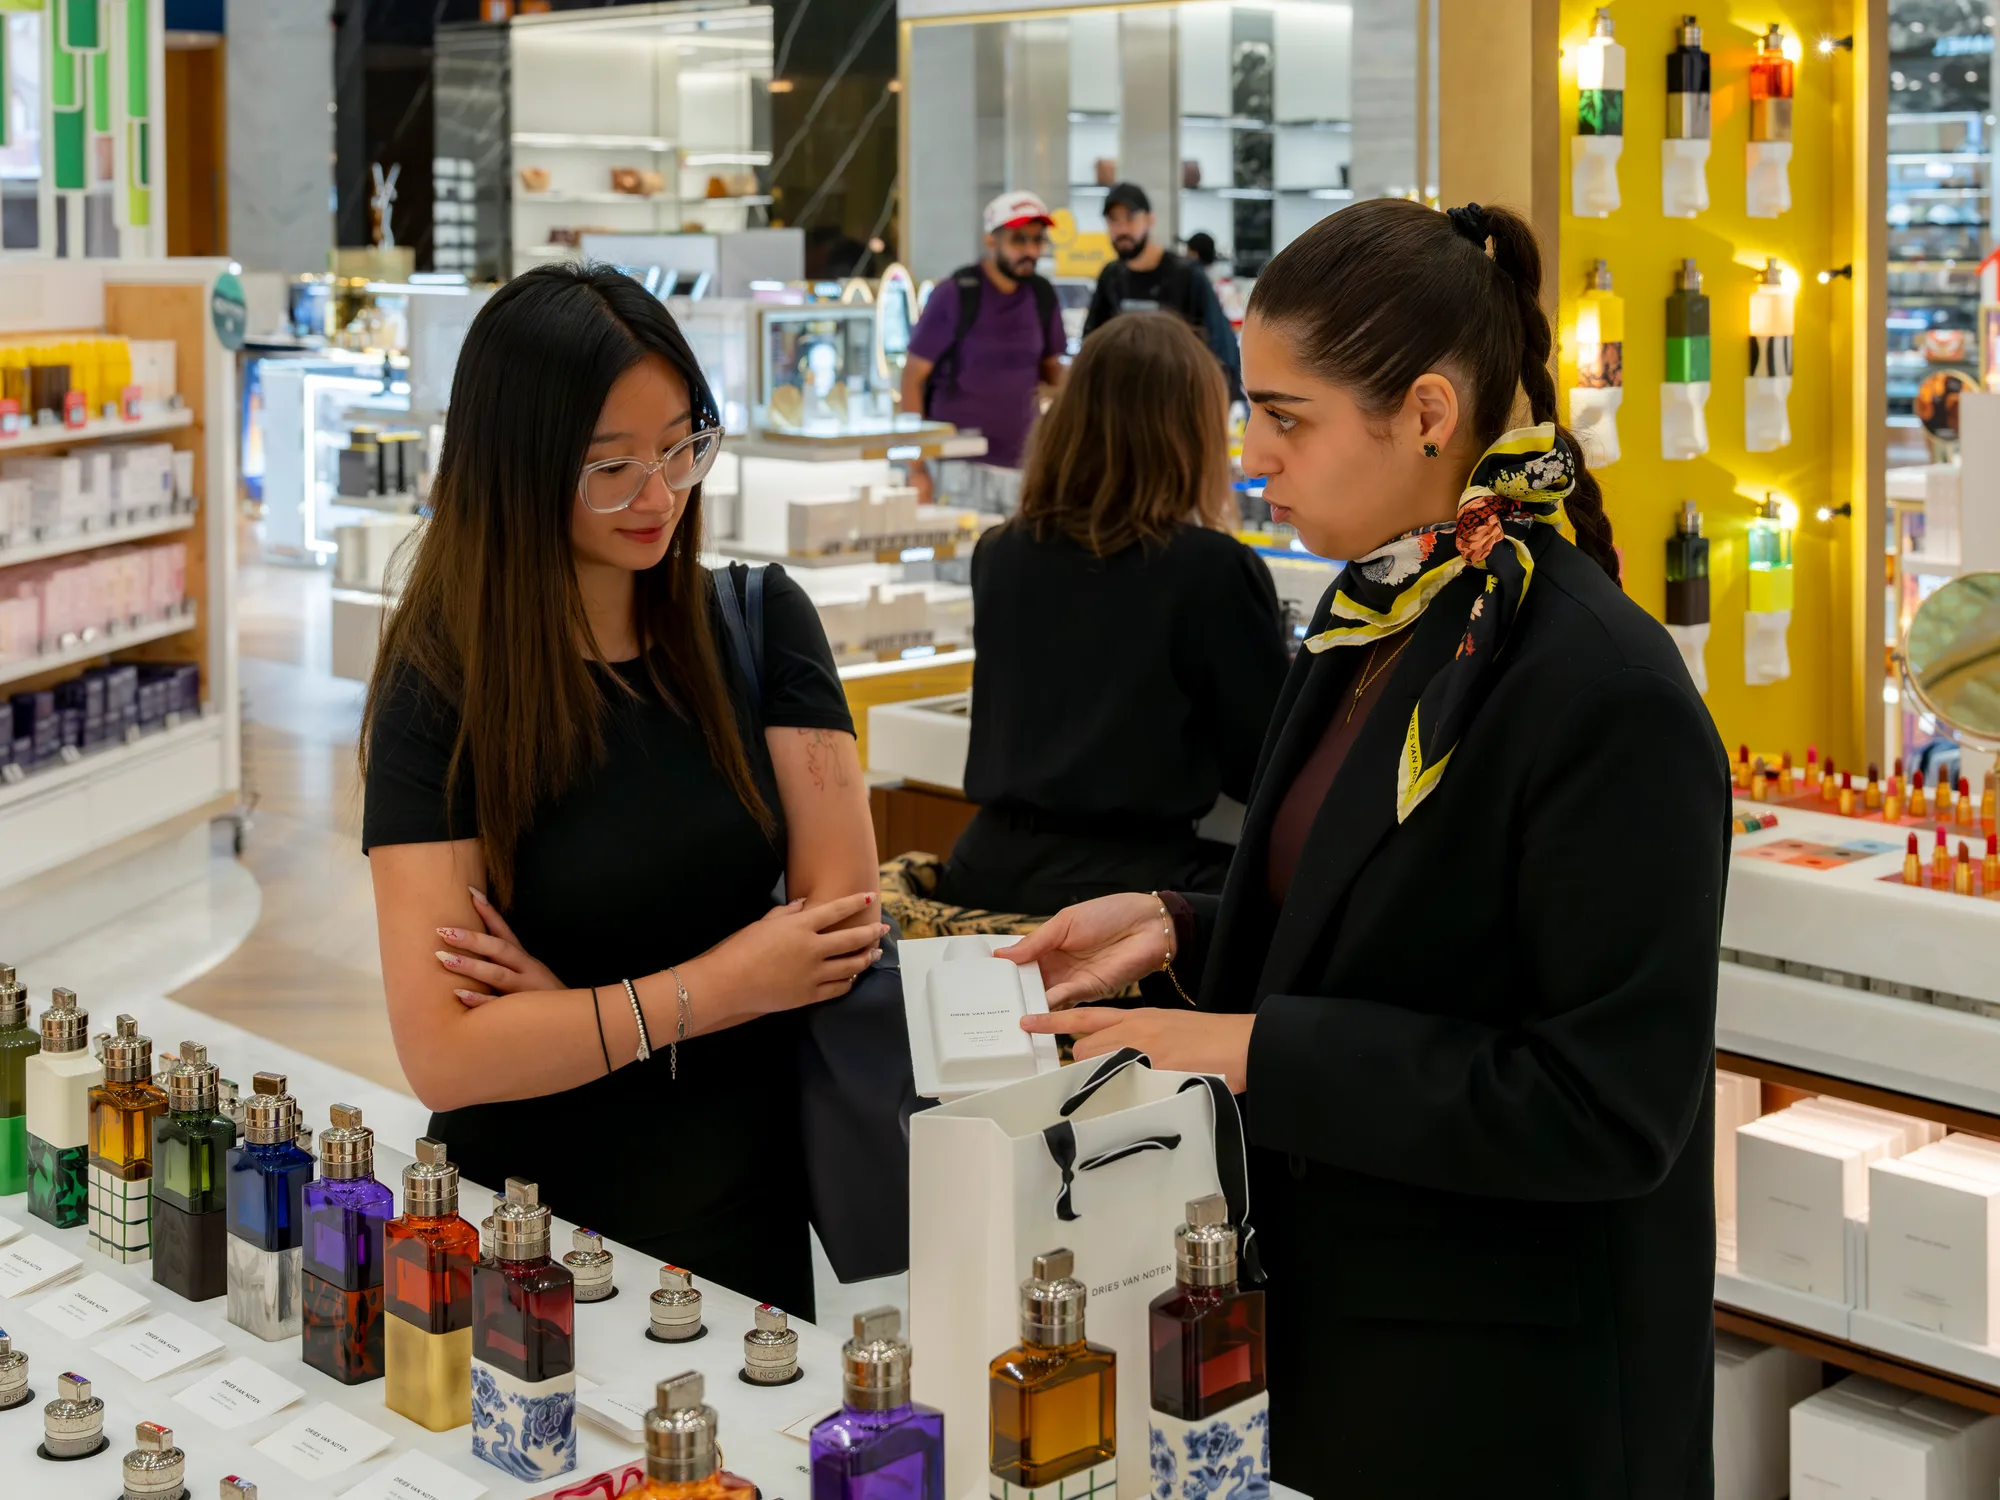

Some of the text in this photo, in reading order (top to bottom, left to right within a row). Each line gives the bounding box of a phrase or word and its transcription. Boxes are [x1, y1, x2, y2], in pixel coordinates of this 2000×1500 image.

[1410, 742, 1418, 763] VAN
[1091, 1281, 1119, 1297] DRIES
[1122, 1274, 1139, 1287] VAN
[1142, 1264, 1172, 1280] NOTEN
[579, 1286, 610, 1297] NOTEN
[74, 1292, 87, 1302] DRIES
[95, 1303, 109, 1313] NOTEN
[145, 1331, 159, 1341] DRIES
[167, 1342, 181, 1354] NOTEN
[759, 1368, 793, 1379] NOTEN
[221, 1379, 237, 1390] DRIES
[244, 1392, 262, 1405] NOTEN
[305, 1427, 321, 1438] DRIES
[330, 1440, 348, 1453] NOTEN
[393, 1476, 411, 1488] DRIES
